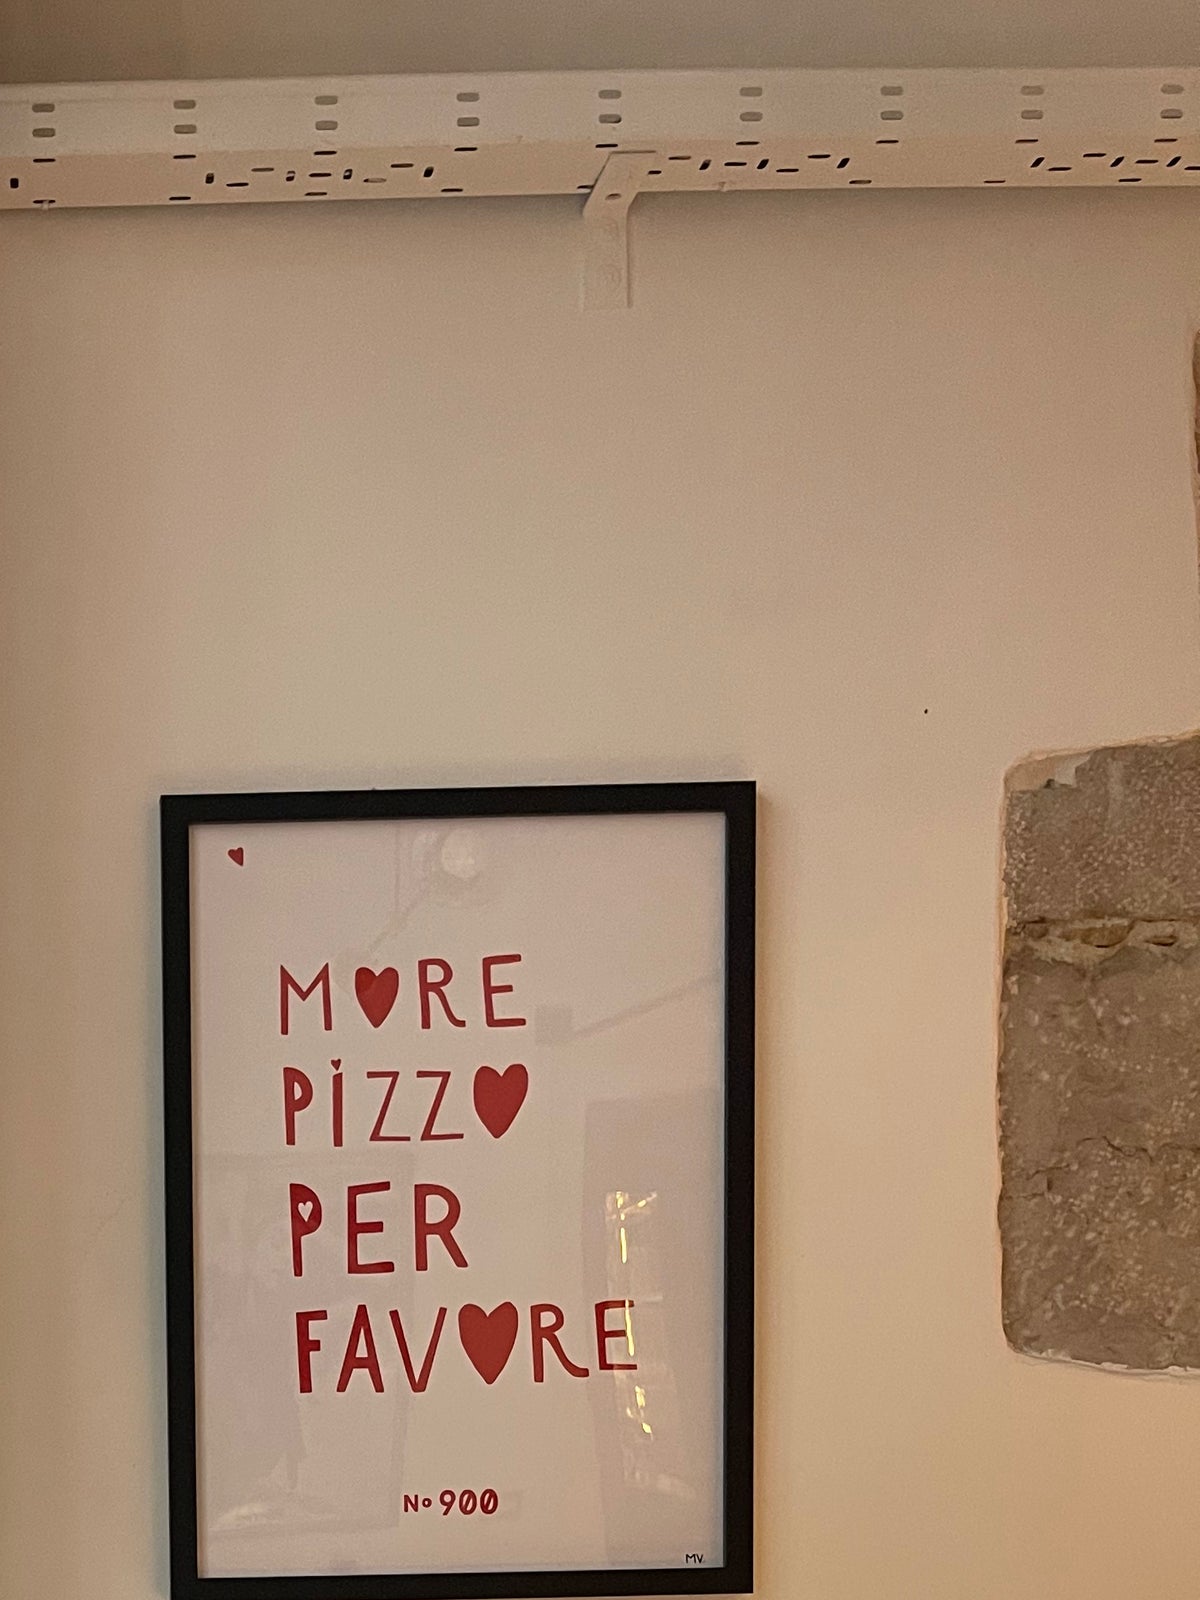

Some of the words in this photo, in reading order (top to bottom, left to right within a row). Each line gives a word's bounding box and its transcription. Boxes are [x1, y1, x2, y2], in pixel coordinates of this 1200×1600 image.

[289, 1180, 469, 1278] PER
[439, 1488, 499, 1516] 900
[685, 1553, 704, 1564] MV
